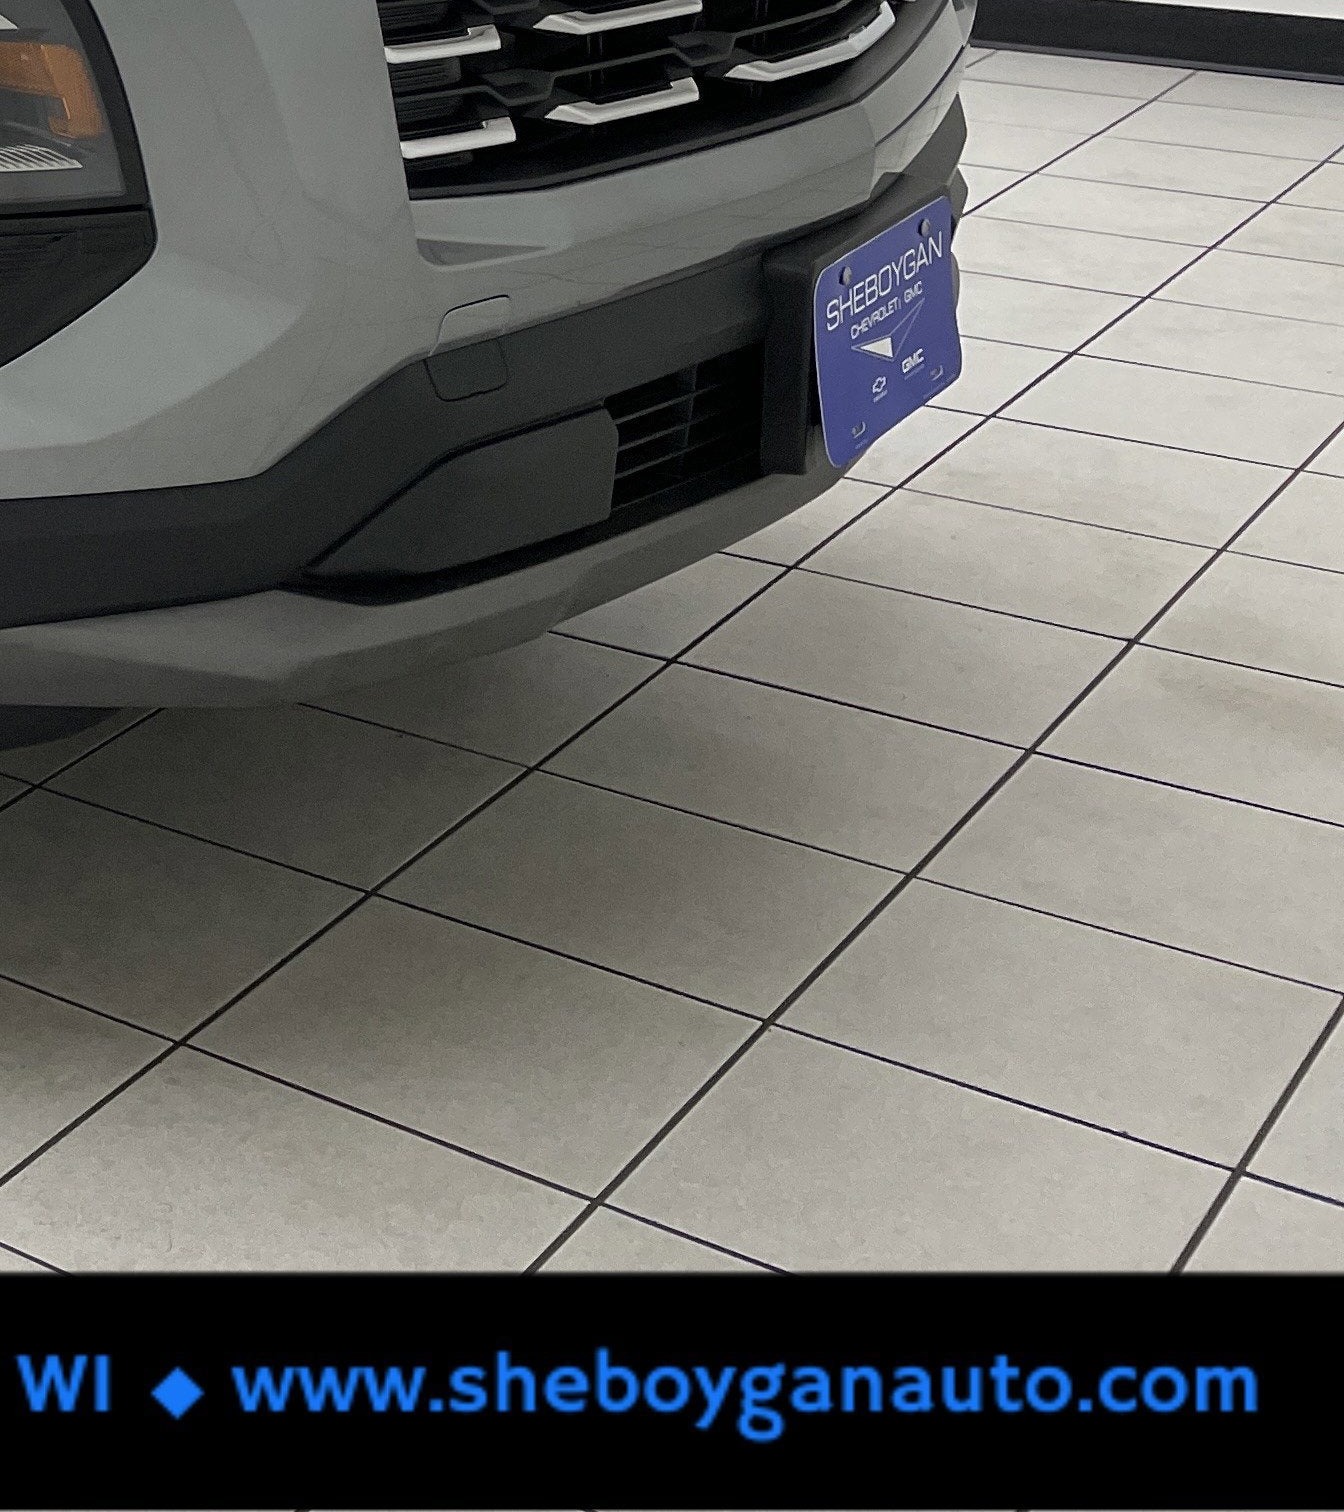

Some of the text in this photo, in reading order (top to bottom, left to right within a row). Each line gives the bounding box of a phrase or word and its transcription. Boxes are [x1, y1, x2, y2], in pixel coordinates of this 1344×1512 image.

[826, 230, 943, 331] SHEBOYGAN
[850, 296, 898, 340] CHEVROLET
[901, 348, 925, 374] GMC
